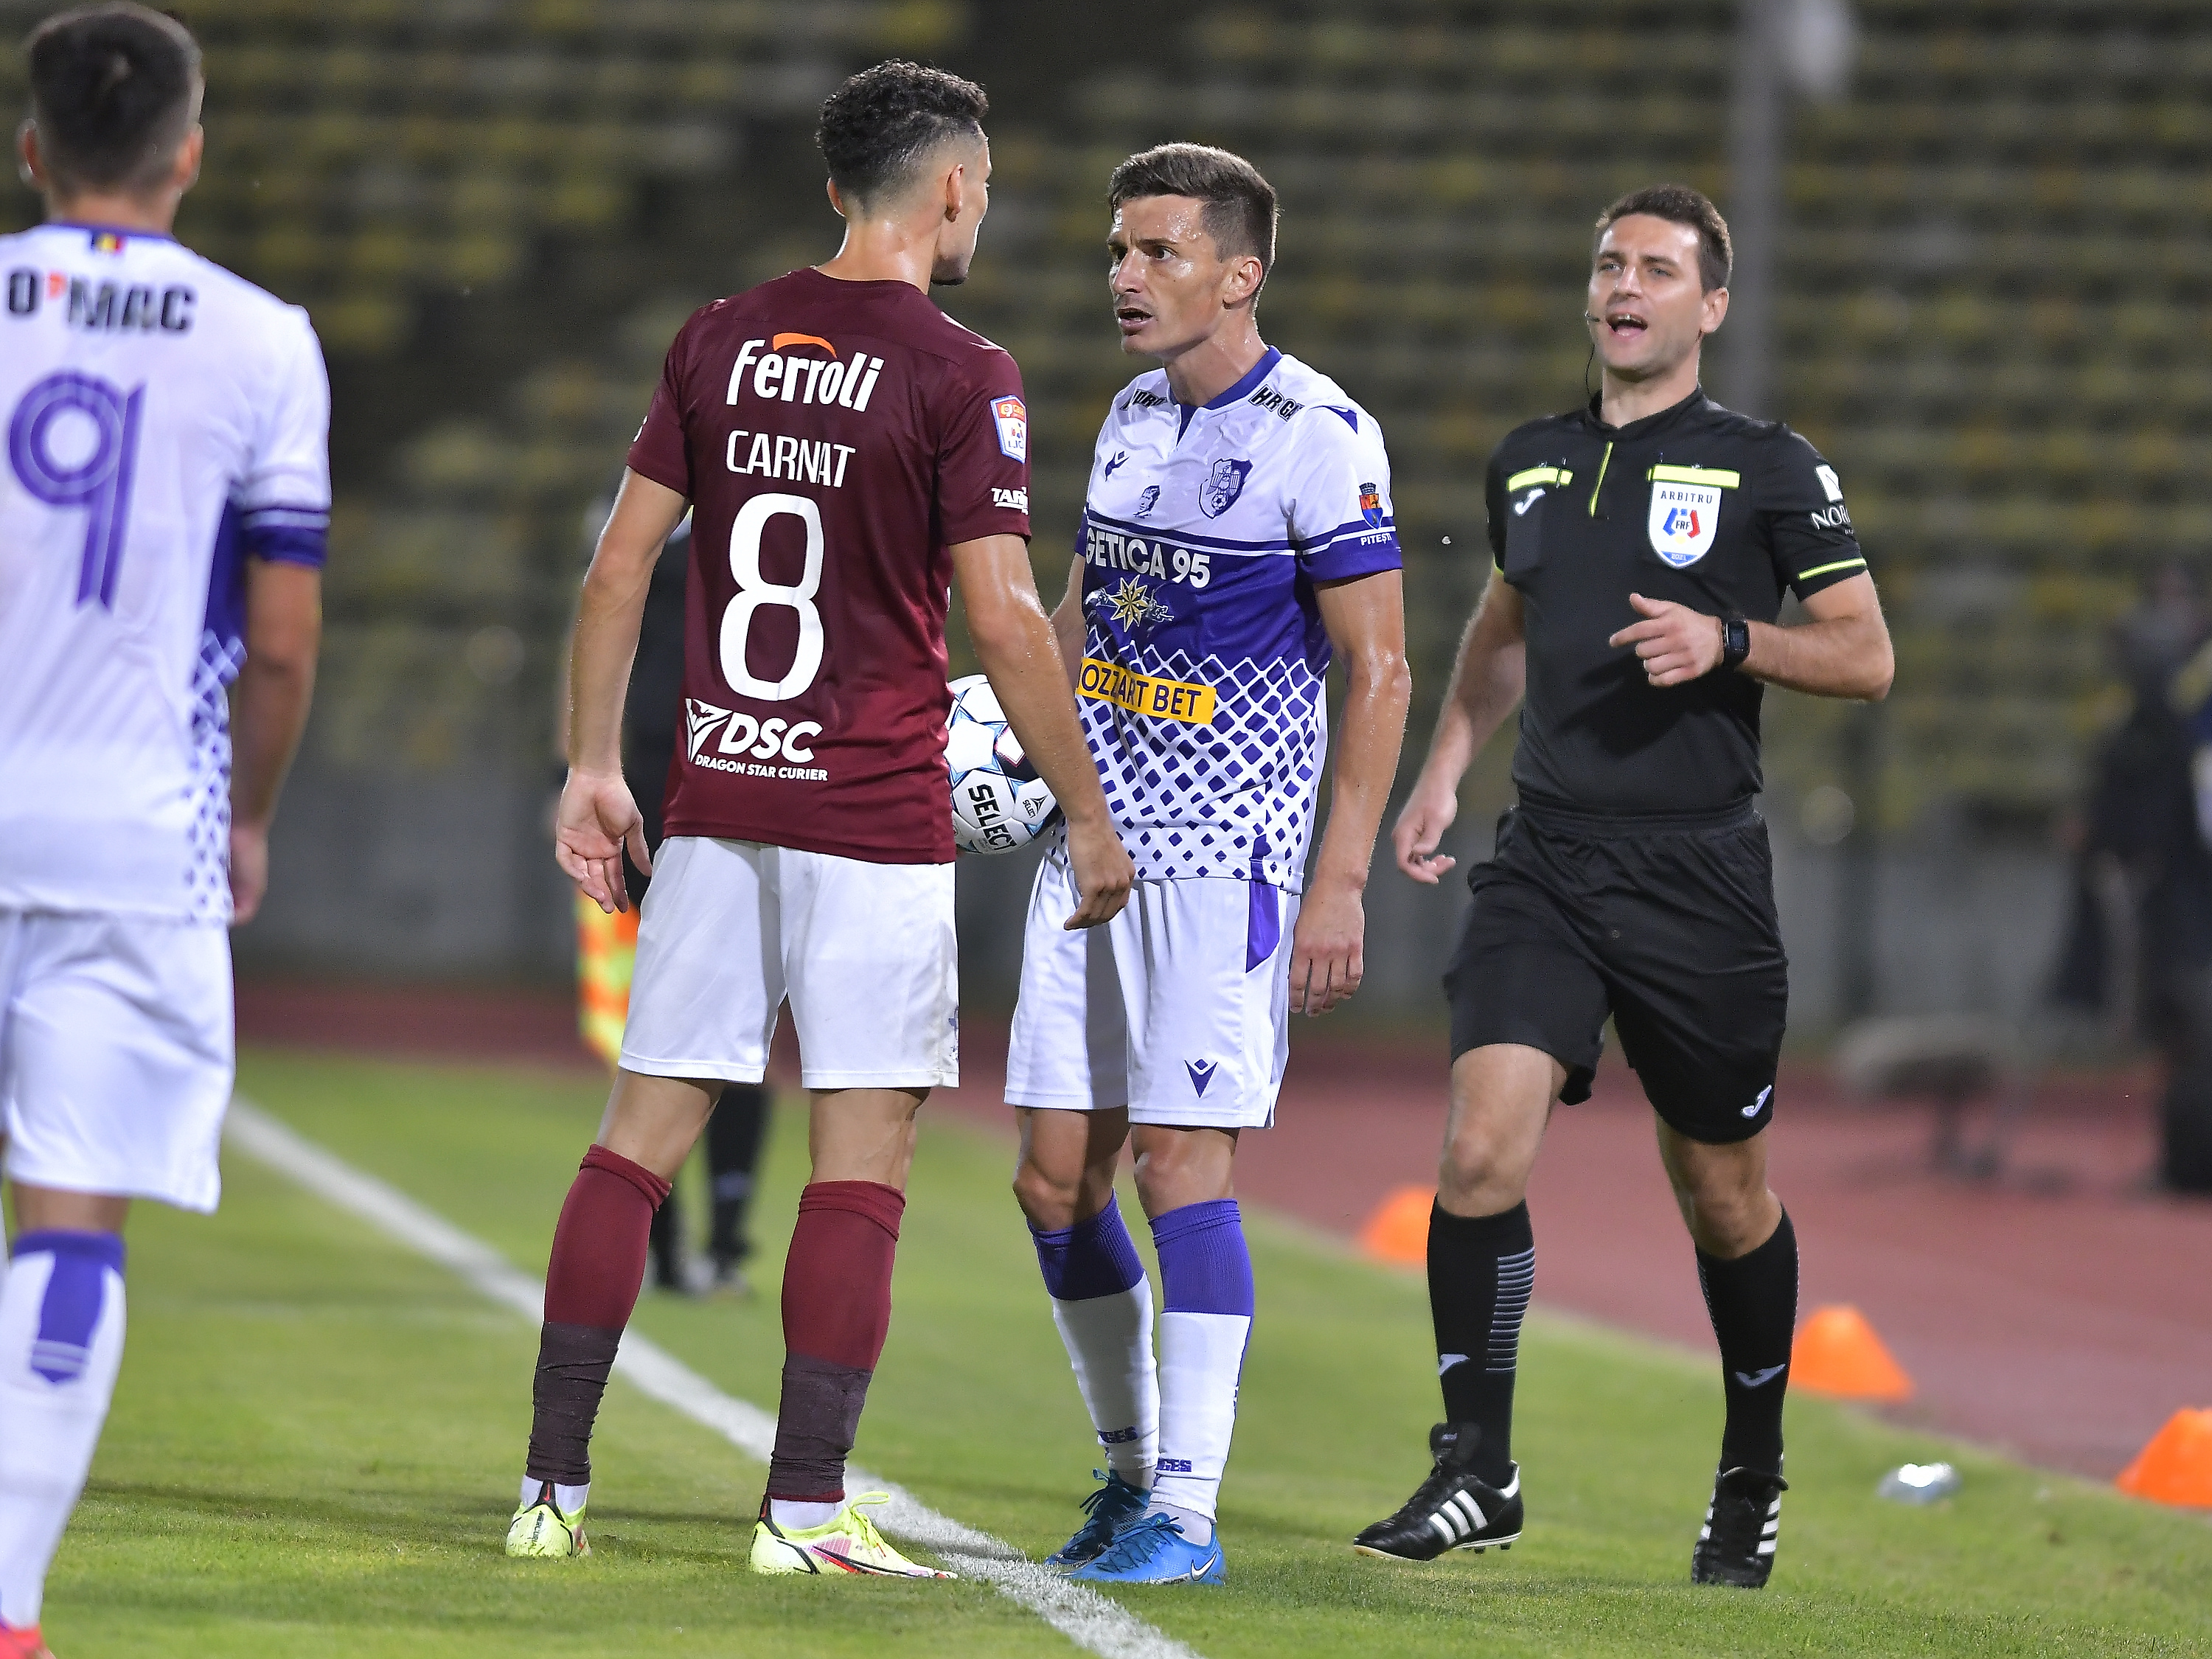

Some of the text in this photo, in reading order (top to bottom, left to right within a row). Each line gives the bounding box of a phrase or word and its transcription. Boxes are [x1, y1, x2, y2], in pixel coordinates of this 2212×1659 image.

[726, 338, 885, 412] Ferroli
[726, 430, 856, 488] CARNAT
[9, 370, 147, 613] 9
[1660, 490, 1713, 504] ARBITRU
[1675, 520, 1691, 530] FRF
[1086, 528, 1211, 588] GETICA 95
[719, 493, 825, 702] 8
[1077, 664, 1202, 717] OZZART BET
[717, 712, 824, 763] DSC
[695, 754, 829, 782] DRAGON STAR CURIER
[967, 783, 1018, 851] SELECT
[1022, 799, 1037, 818] SELECT
